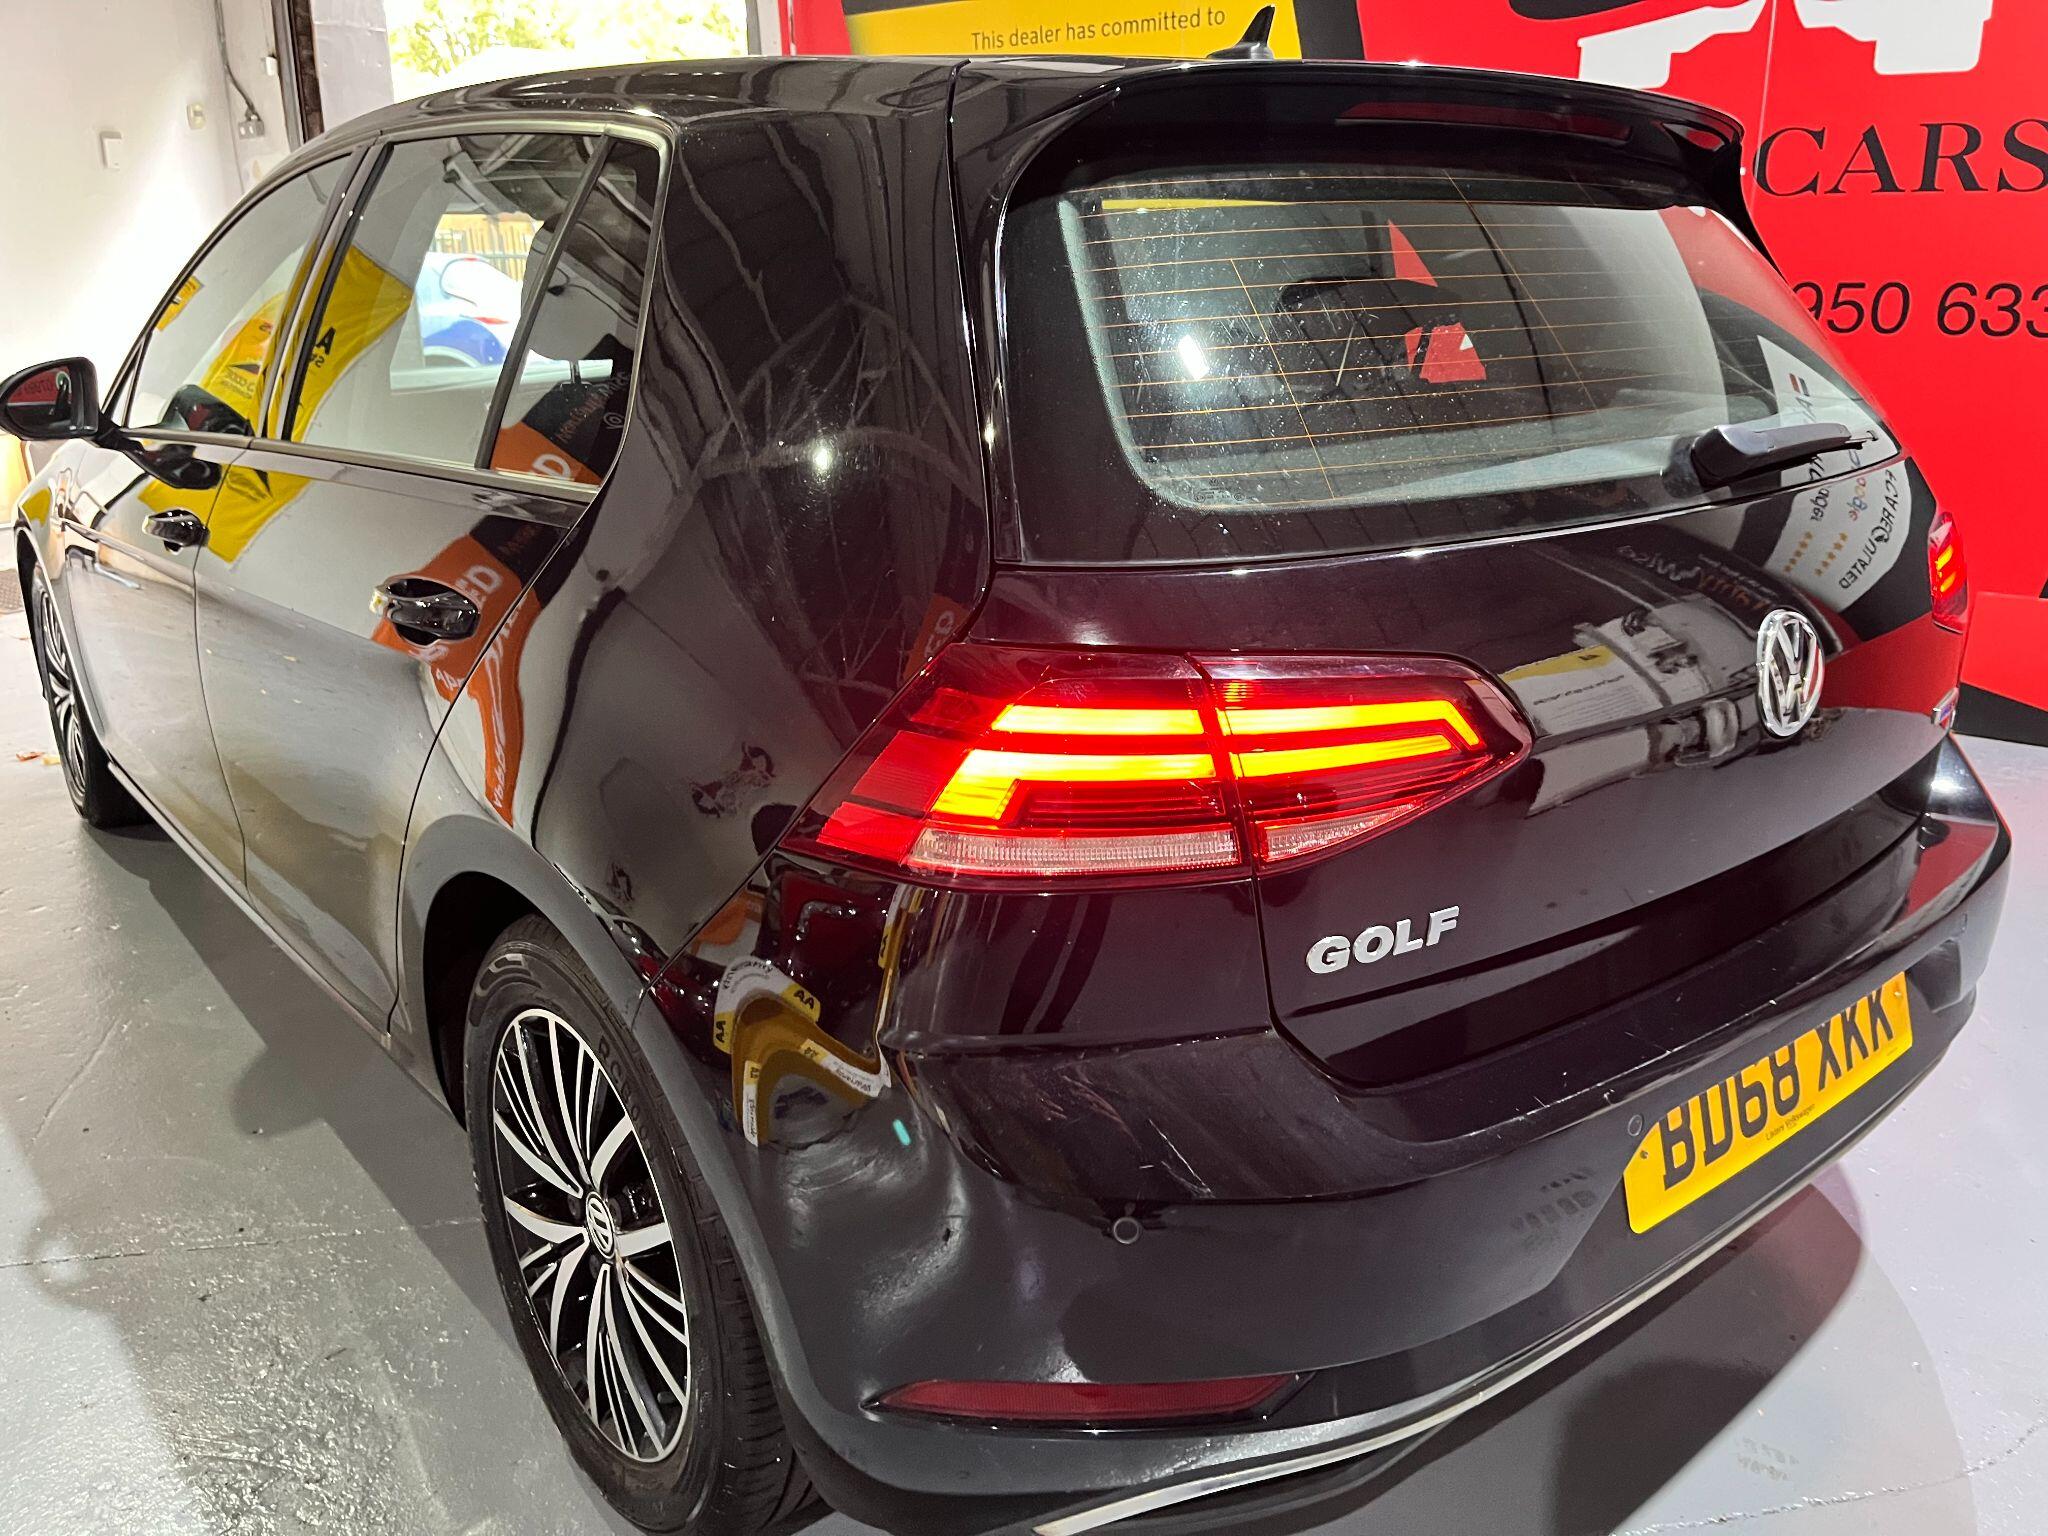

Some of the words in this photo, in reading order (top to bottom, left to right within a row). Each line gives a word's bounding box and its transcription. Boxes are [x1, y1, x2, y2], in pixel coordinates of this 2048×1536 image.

[971, 32, 1004, 50] This
[1009, 25, 1061, 46] dealer
[1066, 22, 1096, 41] has
[1101, 8, 1201, 37] committed
[1207, 7, 1226, 26] to
[1752, 118, 2048, 197] CARS
[1306, 905, 1460, 975] GOLF
[1658, 1041, 1801, 1192] BD68
[1815, 987, 1895, 1093] XKK
